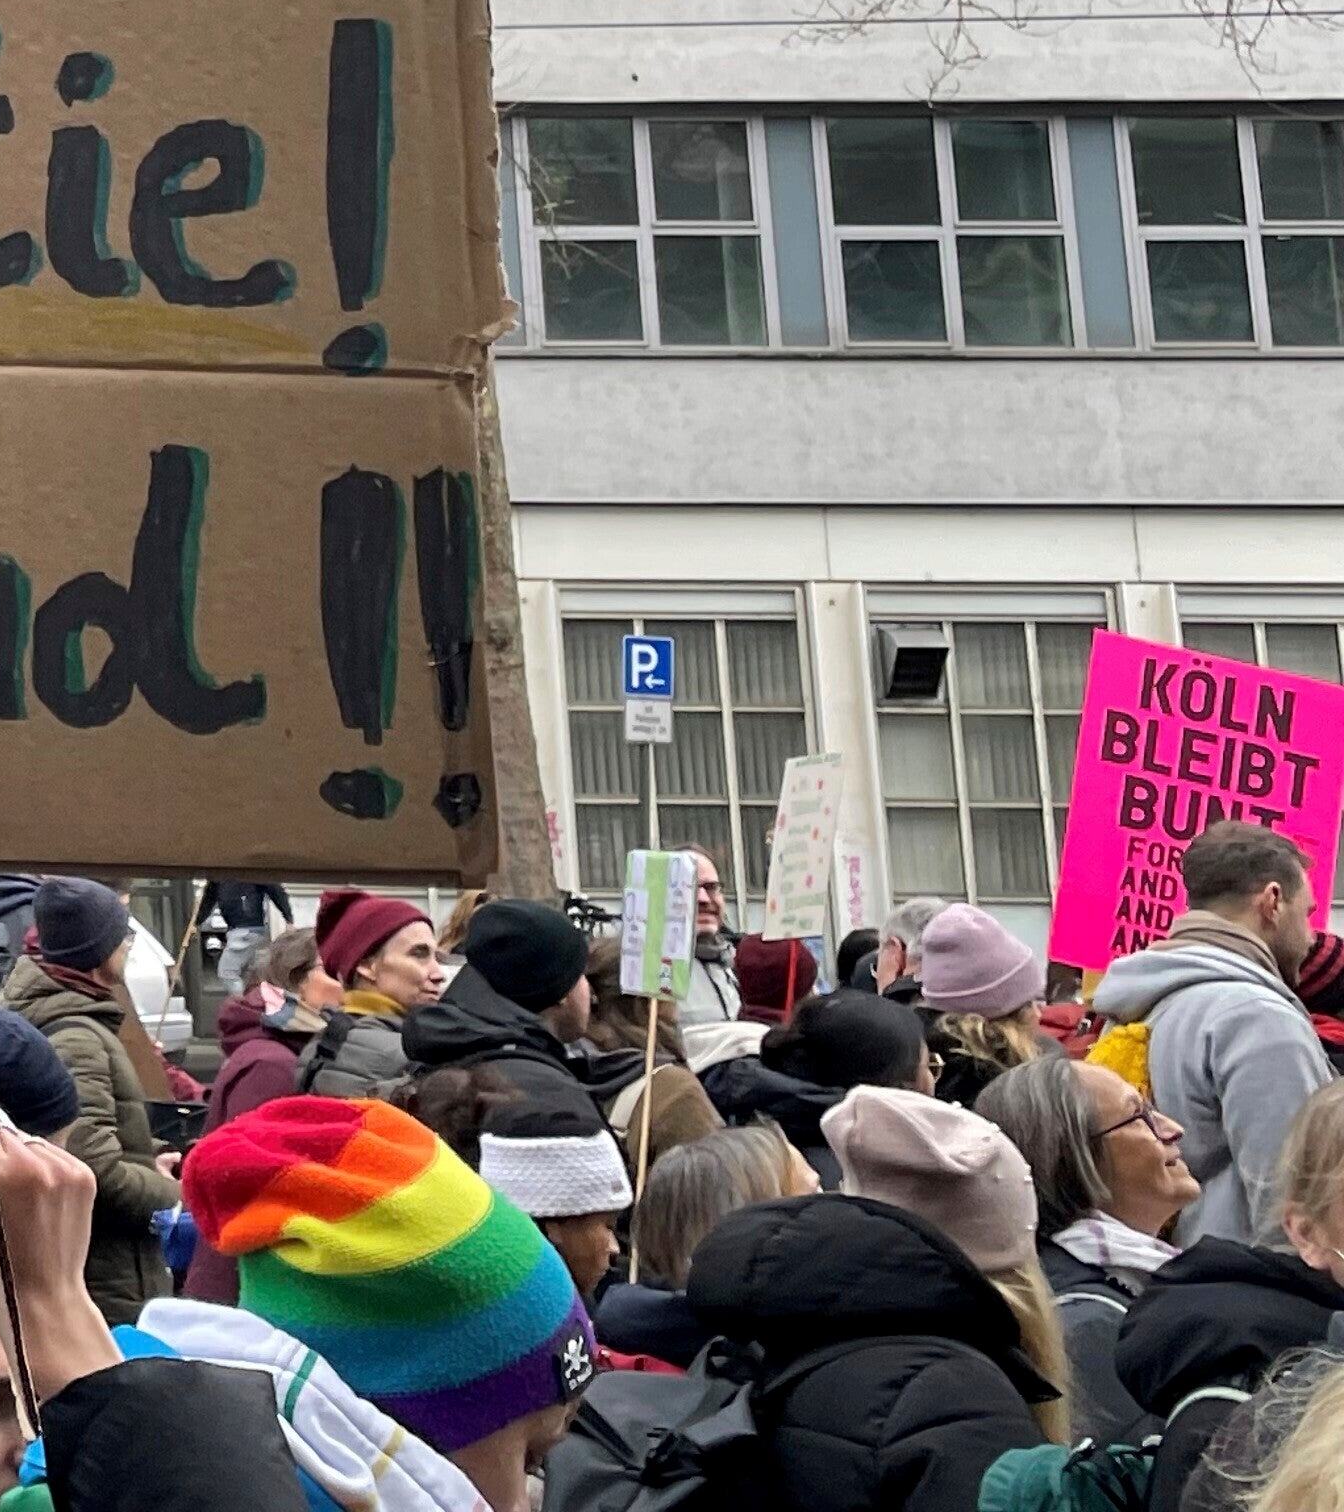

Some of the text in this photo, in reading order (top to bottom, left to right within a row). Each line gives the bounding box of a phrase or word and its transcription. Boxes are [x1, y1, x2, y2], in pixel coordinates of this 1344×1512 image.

[630, 643, 659, 689] P
[1139, 657, 1297, 744] KÖLN
[1100, 708, 1321, 809] BLEIBT
[1119, 866, 1179, 902] AND
[1115, 895, 1175, 931] AND
[1110, 925, 1167, 955] AN
